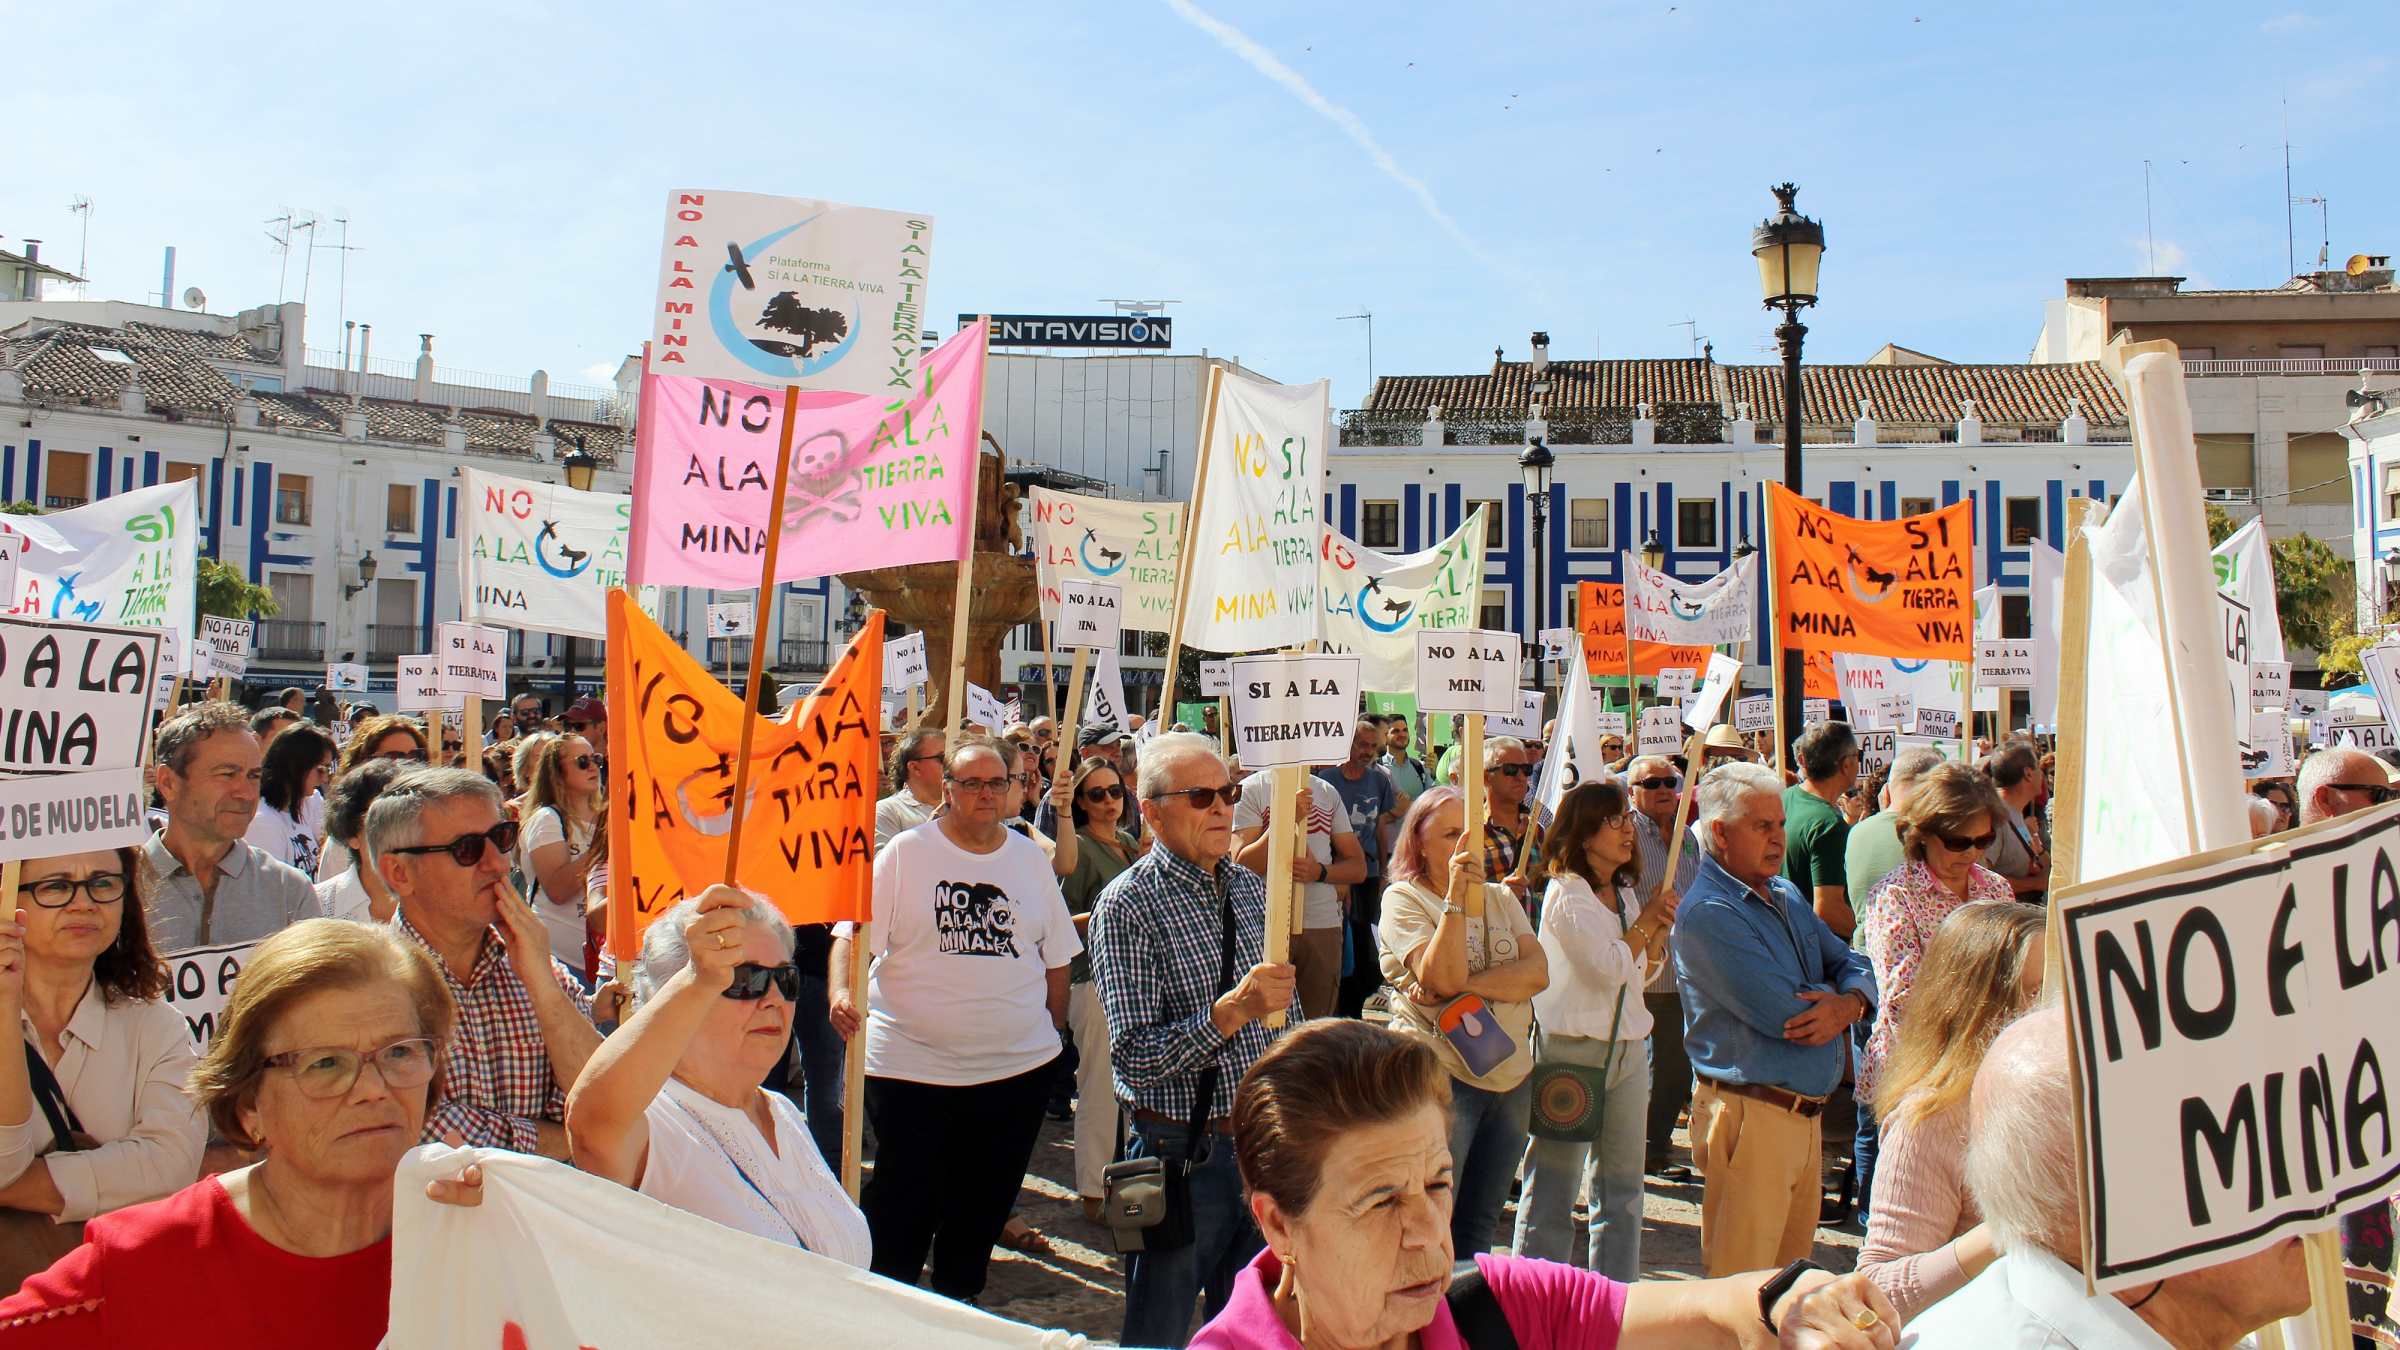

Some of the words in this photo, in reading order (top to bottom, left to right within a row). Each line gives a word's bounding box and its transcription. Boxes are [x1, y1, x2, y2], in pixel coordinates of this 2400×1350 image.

[677, 194, 704, 222] NO
[906, 220, 927, 240] SI
[669, 260, 694, 288] LA
[769, 255, 831, 272] Plataforma
[767, 270, 779, 281] SI
[782, 271, 790, 281] A
[793, 272, 809, 284] LA
[811, 274, 856, 290] TIERRA
[858, 281, 885, 294] VIVA
[661, 301, 693, 363] MINA
[699, 385, 772, 434] NO
[1234, 432, 1267, 478] NO
[1281, 437, 1306, 480] SI
[863, 454, 944, 491] TIERRA
[485, 486, 533, 519] NO
[878, 498, 953, 530] VIVA
[1037, 499, 1074, 525] NO
[126, 505, 175, 543] SI
[1142, 511, 1176, 535] SI
[1794, 507, 1833, 544] NO
[1904, 516, 1948, 550] SI
[1273, 536, 1313, 567] TIERRA
[2211, 552, 2238, 587] SI
[1068, 593, 1085, 604] NO
[1098, 596, 1115, 608] LA
[1215, 588, 1277, 623] MINA
[1902, 588, 1960, 609] TIERRA
[205, 619, 220, 633] NO
[224, 622, 231, 634] A
[235, 623, 250, 637] LA
[1790, 612, 1856, 637] MINA
[1917, 621, 1964, 644] VIVA
[2225, 607, 2248, 665] LA
[209, 637, 239, 652] MINA
[452, 638, 465, 649] SI
[1428, 646, 1455, 659] NO
[1468, 647, 1480, 660] A
[1485, 648, 1504, 662] LA
[1985, 649, 1995, 657] SI
[2014, 649, 2028, 657] LA
[24, 634, 61, 688] A
[78, 638, 146, 694] LA
[1587, 650, 1624, 662] MINA
[1671, 650, 1702, 663] VIVA
[406, 666, 423, 676] NO
[905, 664, 922, 674] MINA
[1845, 669, 1885, 689] MINA
[2256, 671, 2263, 679] A
[2269, 672, 2281, 680] LA
[1249, 682, 1271, 699] SI
[1285, 681, 1300, 697] A
[1310, 679, 1340, 696] LA
[1524, 700, 1535, 708] LA
[1920, 710, 1932, 721] NO
[1935, 712, 1941, 722] A
[1944, 712, 1956, 723] LA
[0, 707, 98, 766] INA
[1924, 725, 1948, 736] MINA
[2364, 728, 2376, 747] A
[1863, 735, 1872, 751] A
[1876, 735, 1893, 751] LA
[11, 803, 43, 838] DE
[48, 793, 141, 834] MUDELA
[779, 824, 872, 873] VIVA
[936, 886, 970, 909] NO
[2095, 905, 2237, 1063] NO
[2179, 1036, 2392, 1228] MINA
